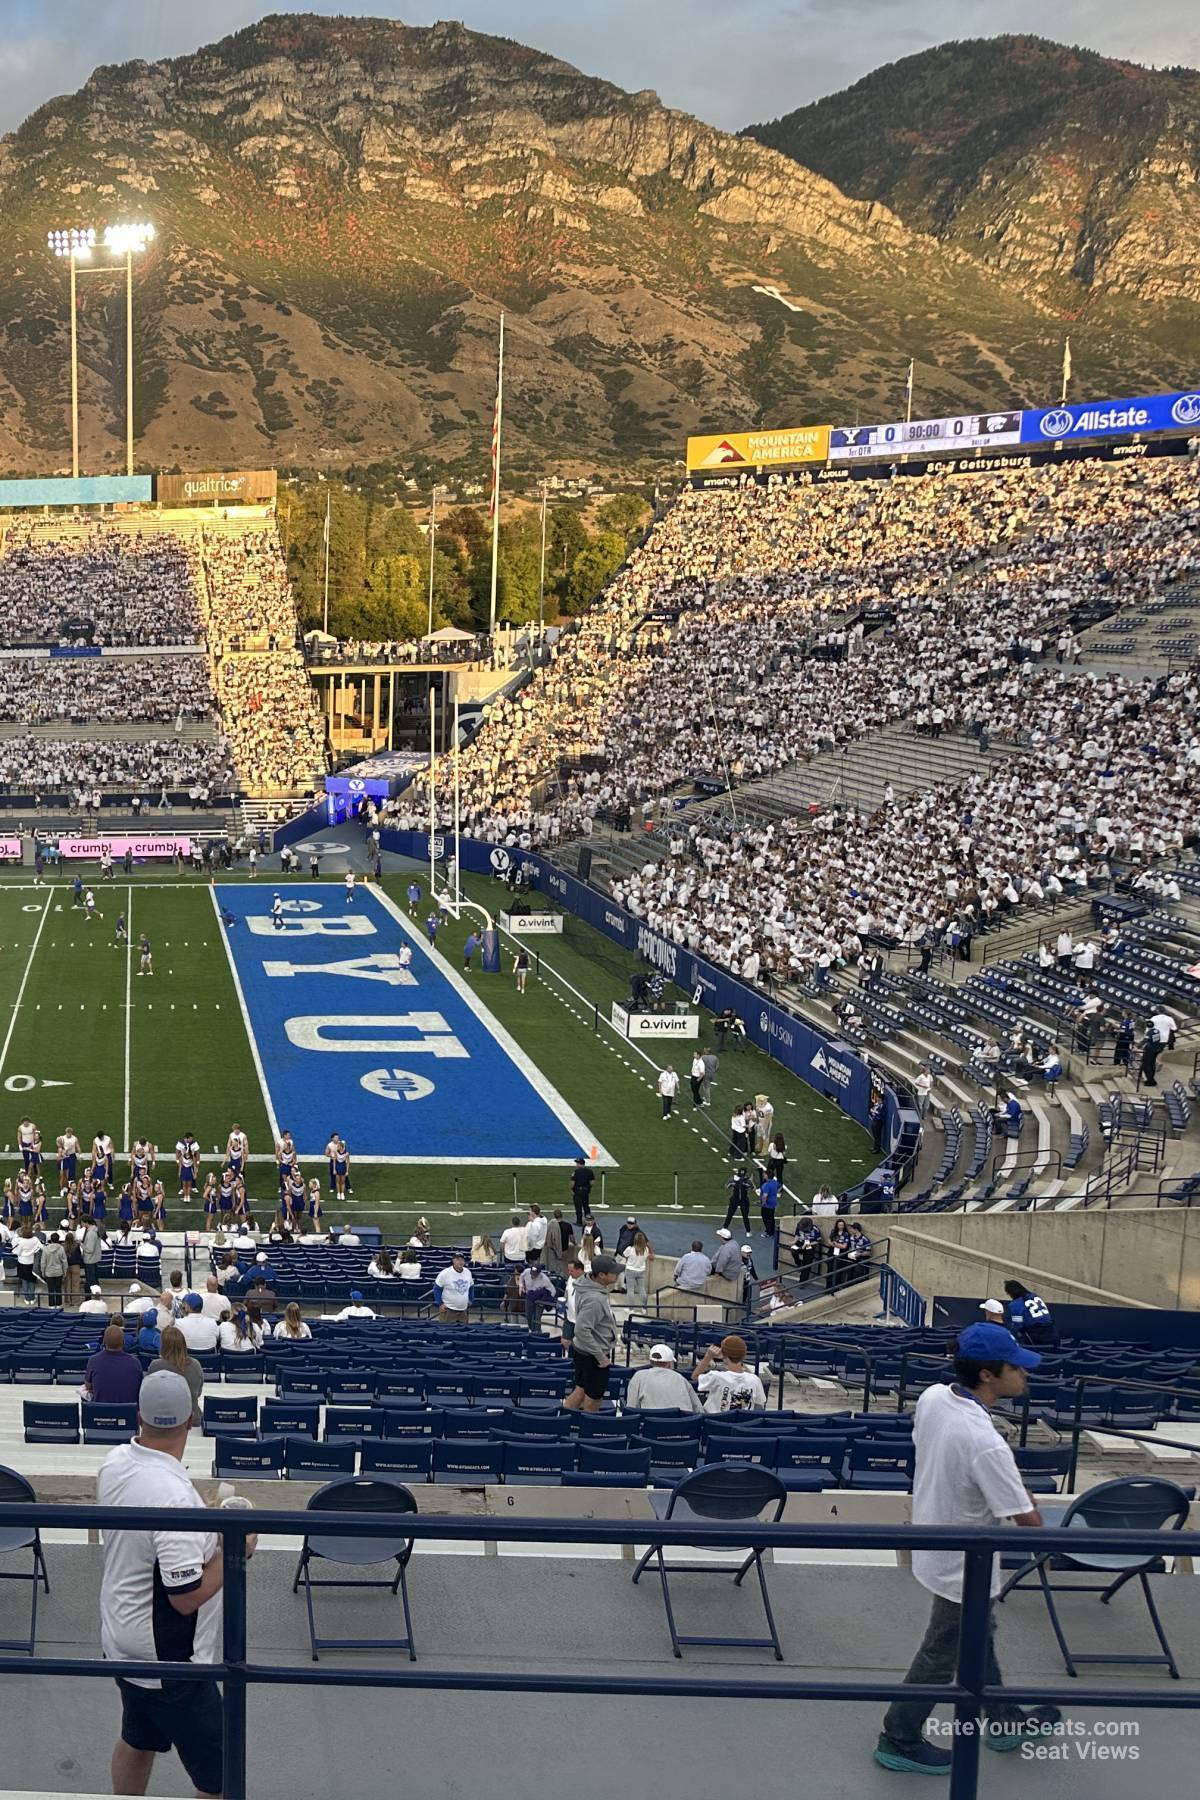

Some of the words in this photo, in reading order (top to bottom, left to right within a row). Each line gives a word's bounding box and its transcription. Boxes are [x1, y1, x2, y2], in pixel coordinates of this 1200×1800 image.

[1073, 406, 1148, 431] Allstate
[884, 427, 895, 442] 0
[908, 424, 940, 439] 90:00
[953, 420, 963, 435] 0
[748, 432, 818, 449] MOUNTAIN
[751, 446, 813, 460] AMERICA
[1113, 444, 1148, 456] smarty
[959, 456, 1031, 471] Gettysburg
[184, 476, 238, 494] qualtrics
[70, 844, 112, 853] crumbl
[135, 843, 178, 852] crumbl
[528, 918, 555, 927] vivint
[245, 915, 471, 1059] BYU
[652, 1019, 687, 1030] vivint
[1024, 1296, 1050, 1319] 23
[830, 1505, 838, 1516] 4
